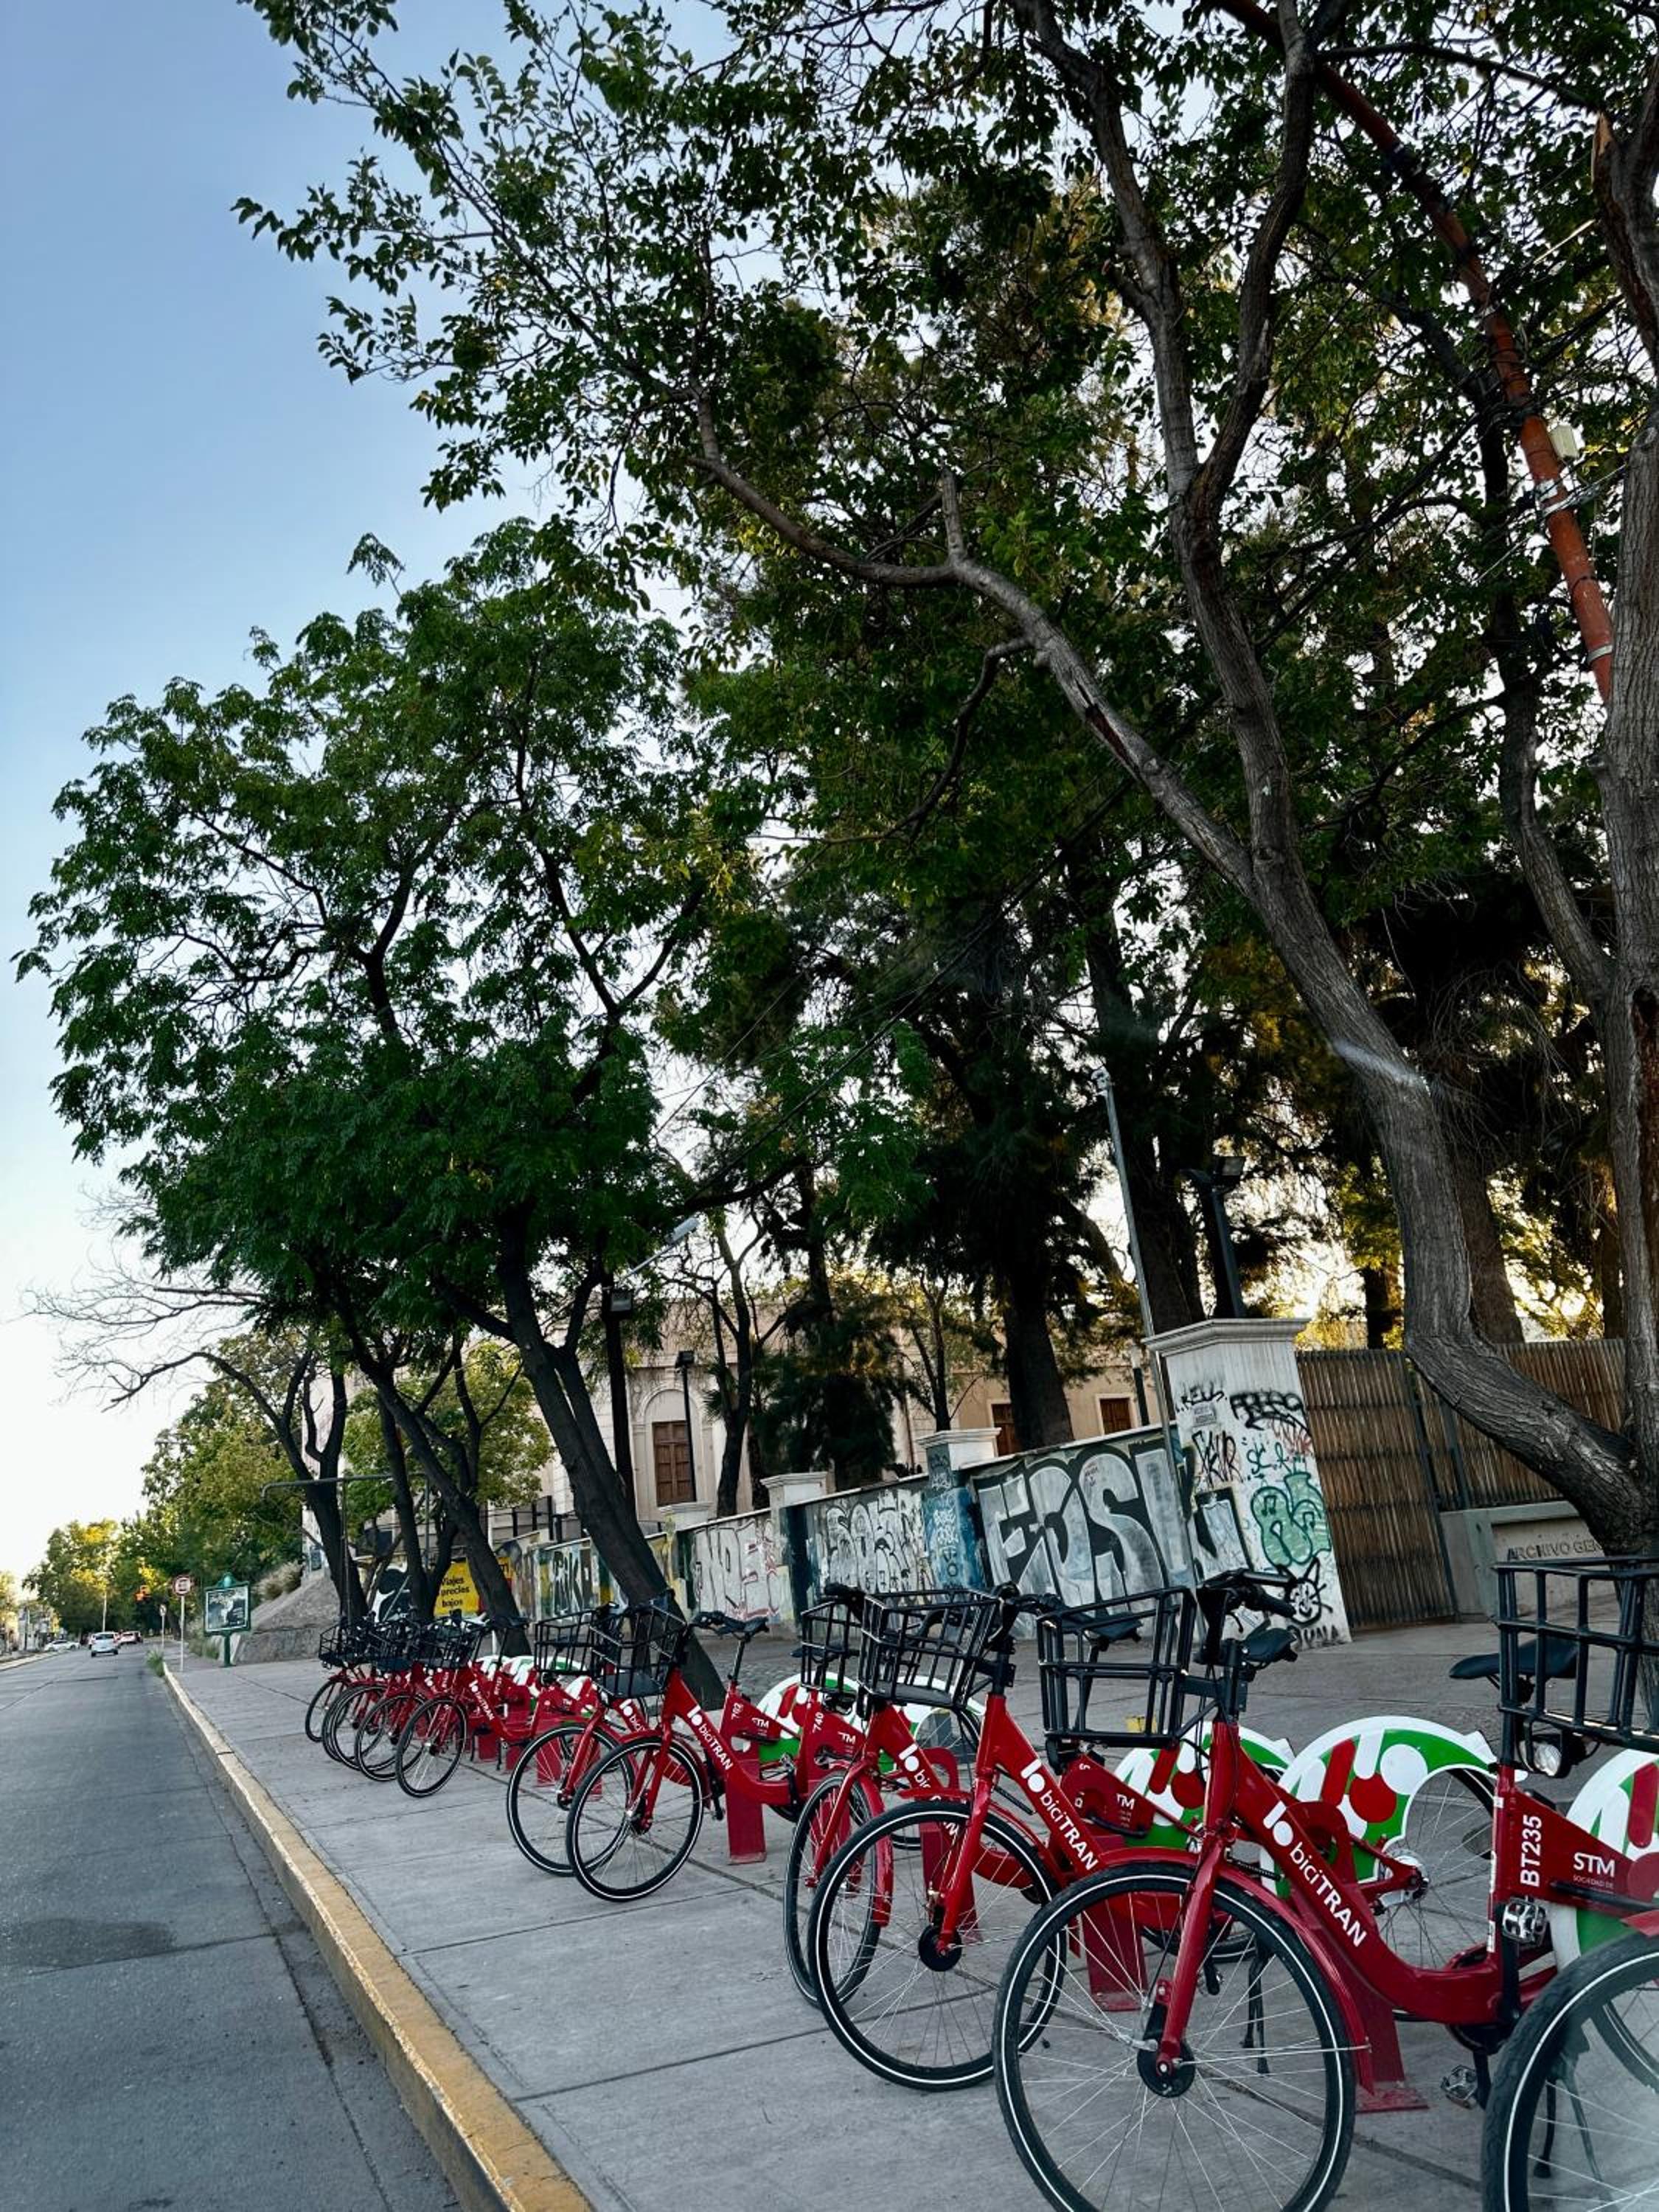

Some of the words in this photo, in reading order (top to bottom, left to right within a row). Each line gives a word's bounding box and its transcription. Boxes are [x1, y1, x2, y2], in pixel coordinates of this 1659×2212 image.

[1508, 1541, 1570, 1561] ARCHIVO
[698, 1719, 734, 1770] biciTRAN
[1040, 1790, 1099, 1871] biciTRAN
[1520, 1815, 1543, 1888] BT235
[1290, 1841, 1367, 1947] biciTRAN
[1573, 1851, 1615, 1878] STM
